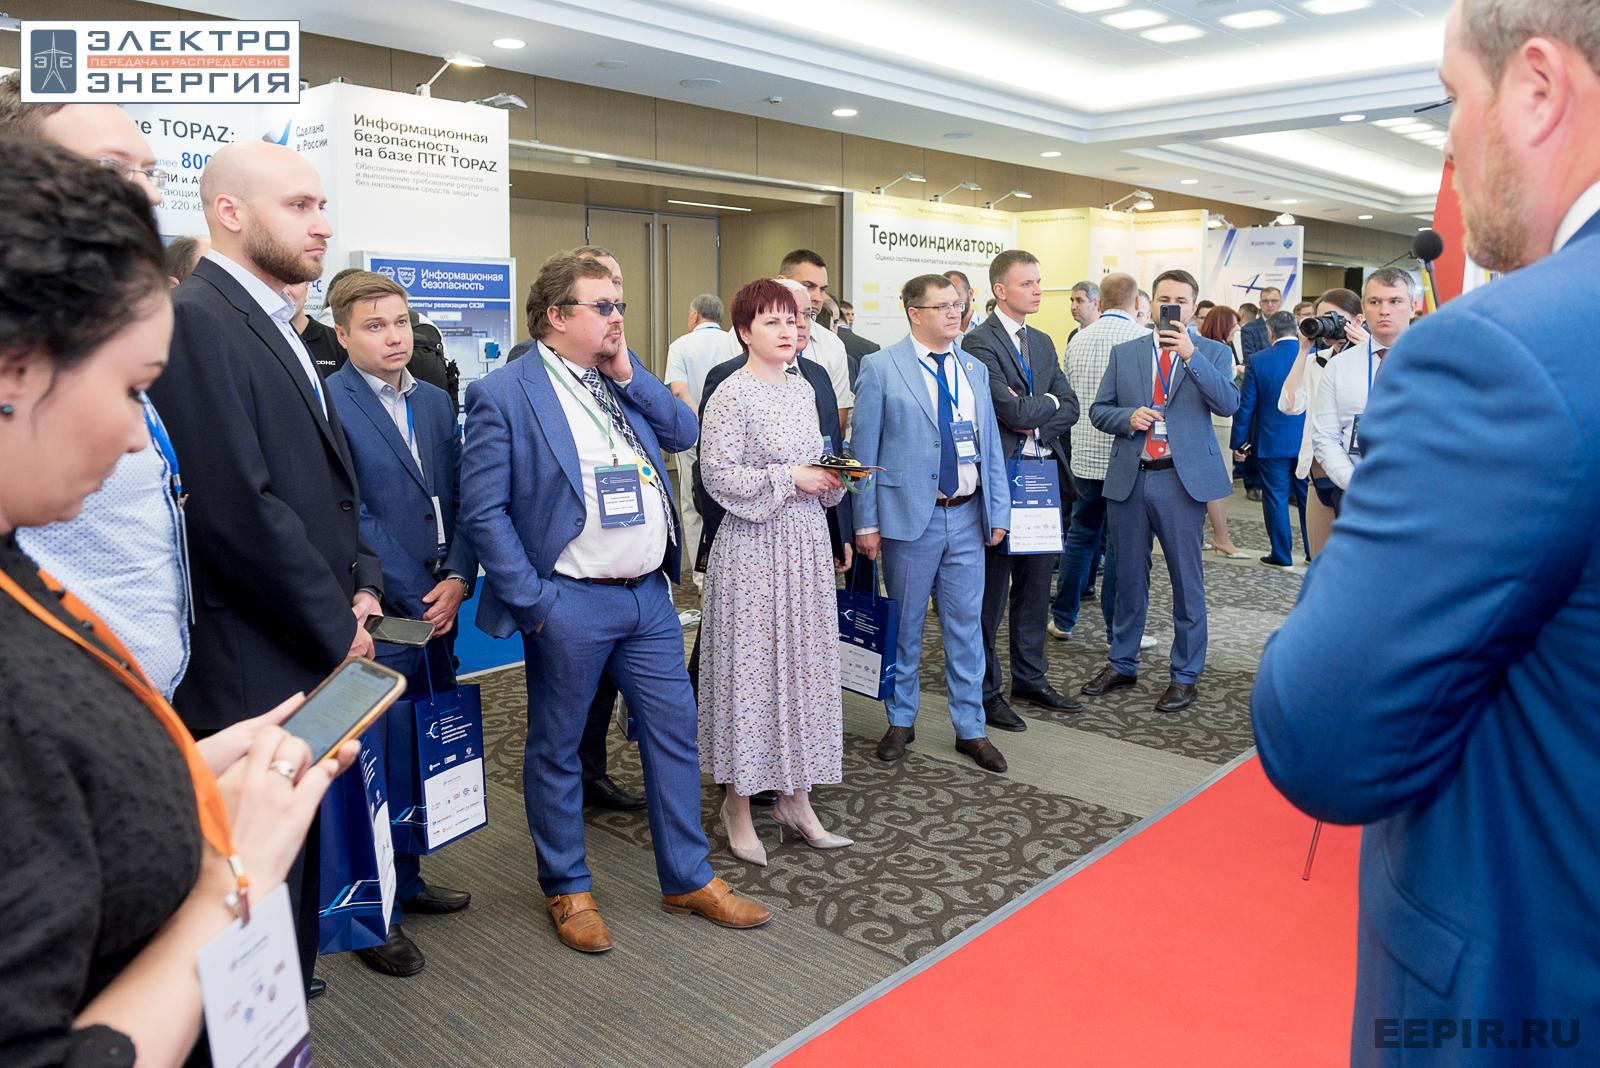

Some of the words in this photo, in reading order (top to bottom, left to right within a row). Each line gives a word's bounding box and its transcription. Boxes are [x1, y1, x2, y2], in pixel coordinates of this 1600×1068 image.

[159, 118, 235, 143] TOPAZ:
[295, 123, 325, 137] Сделано
[353, 113, 489, 144] Информационная
[303, 138, 328, 150] России
[354, 129, 460, 154] безопасность
[354, 146, 373, 158] на
[378, 146, 413, 162] базе
[417, 152, 447, 167] ПТК
[450, 155, 498, 172] TOPAZ
[160, 188, 199, 198] ающих
[869, 224, 1004, 258] Термоиндикаторы
[421, 269, 504, 283] Информационная
[421, 279, 485, 291] безопасность
